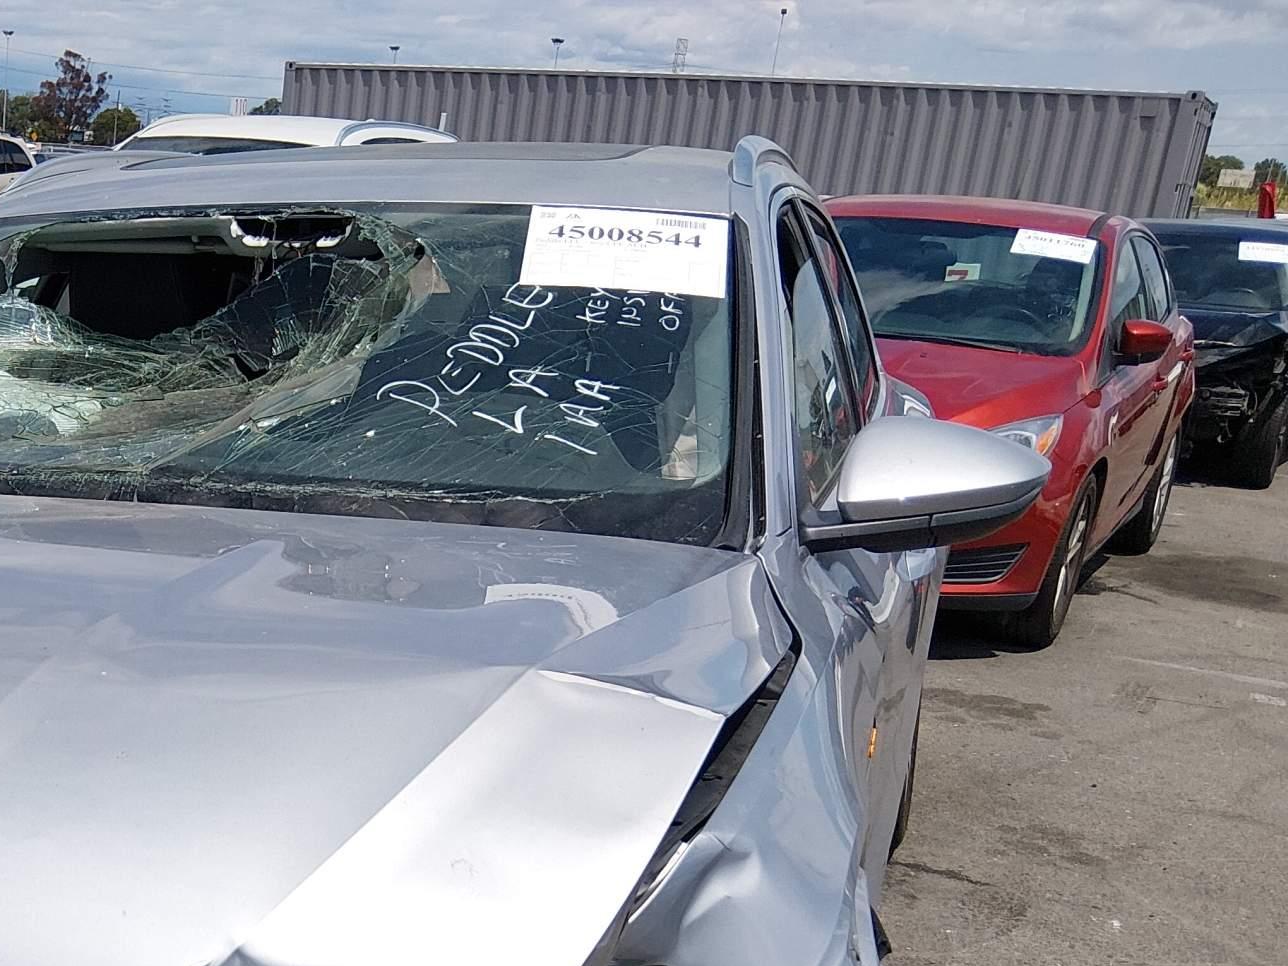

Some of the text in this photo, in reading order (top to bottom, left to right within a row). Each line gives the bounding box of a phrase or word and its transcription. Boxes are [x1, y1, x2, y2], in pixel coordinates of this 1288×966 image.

[548, 224, 702, 248] 45008544
[575, 287, 621, 324] KEY
[376, 281, 553, 428] PEDDLE
[472, 364, 559, 434] LA
